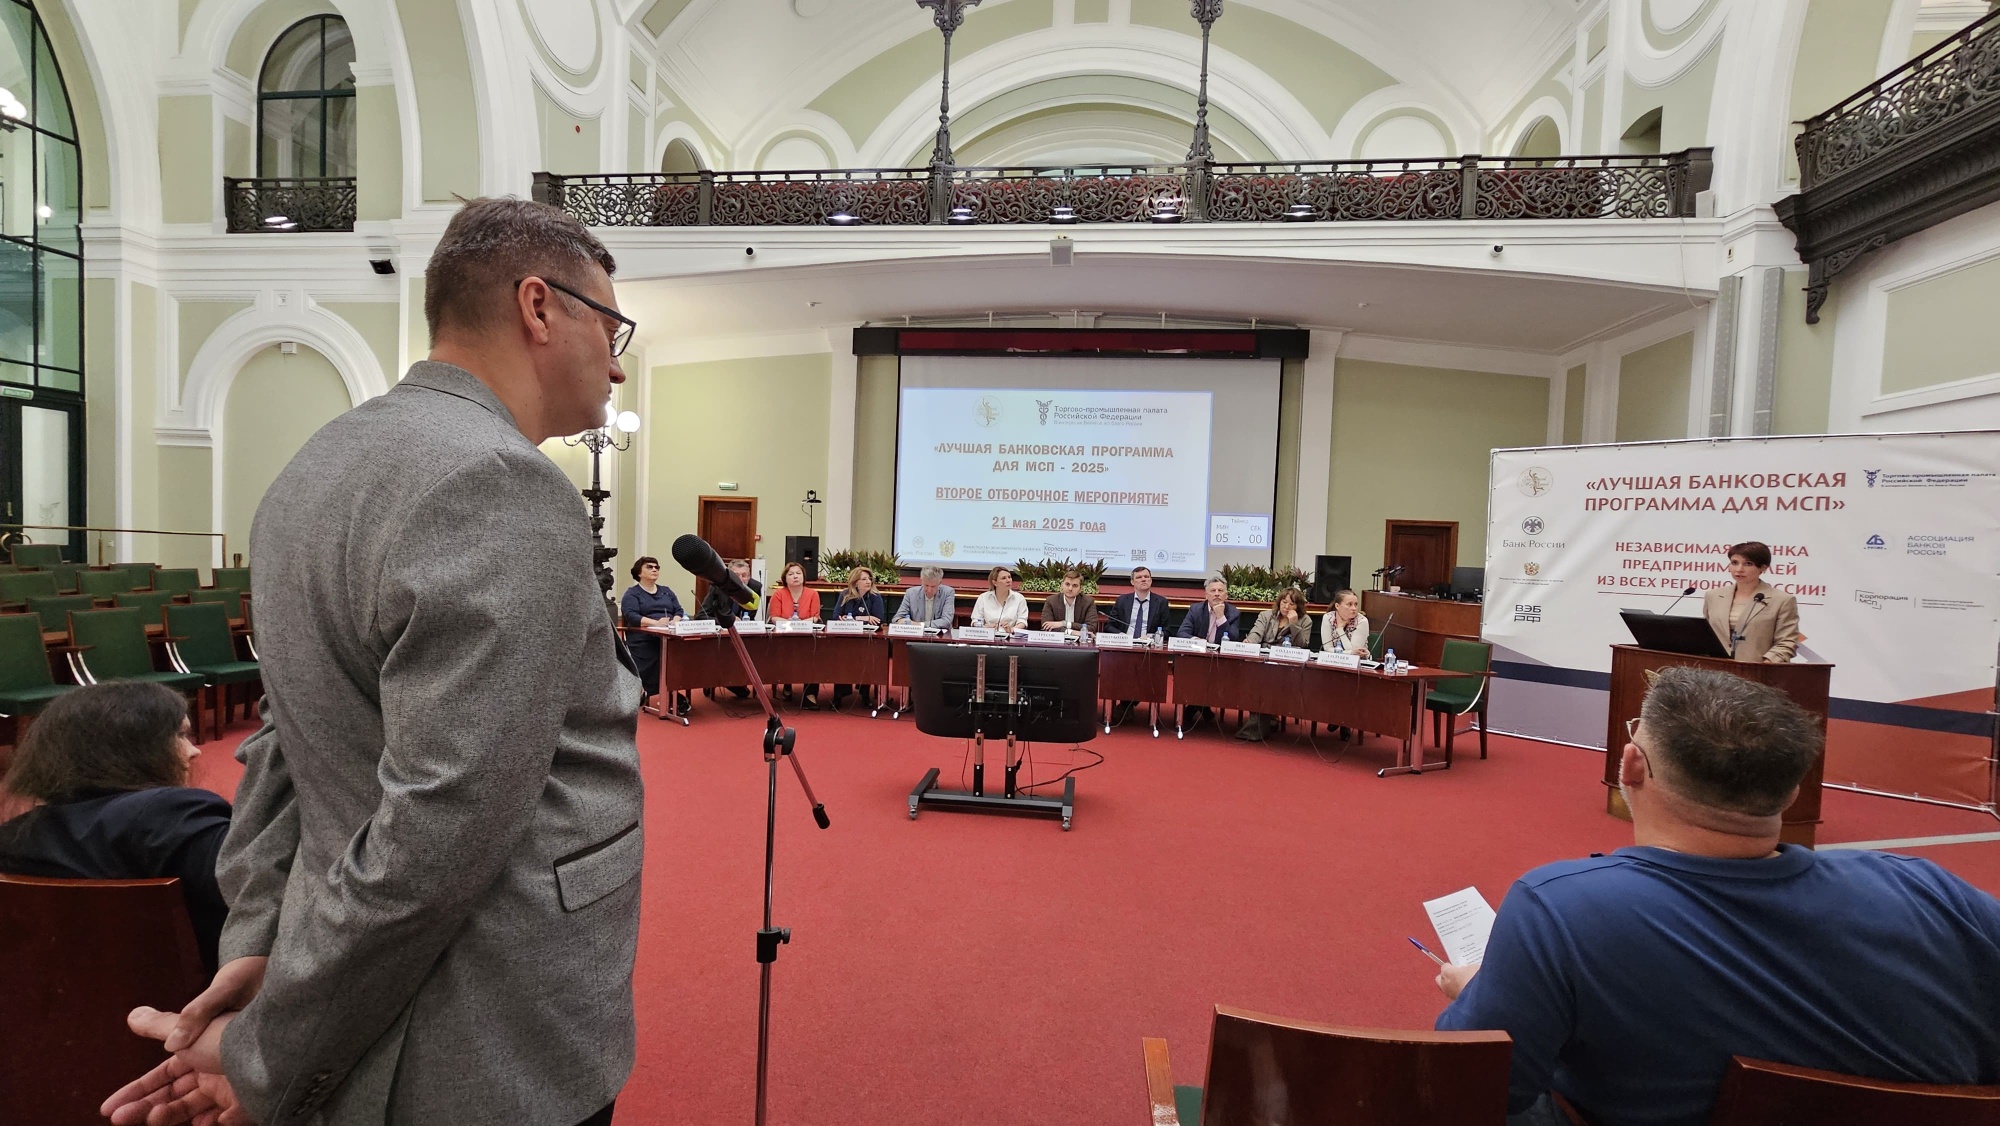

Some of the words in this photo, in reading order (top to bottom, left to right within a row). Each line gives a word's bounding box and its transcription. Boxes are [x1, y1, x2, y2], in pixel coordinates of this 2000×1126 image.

[1053, 412, 1097, 420] Российской
[1099, 413, 1142, 421] Федерации
[1054, 405, 1140, 414] Торгово-промышленная
[933, 442, 992, 454] «ЛУЧШАЯ
[998, 443, 1085, 456] БАНКОВСКАЯ
[1091, 445, 1174, 458] ПРОГРАММА
[992, 460, 1019, 473] ДЛЯ
[1025, 461, 1055, 473] МСП
[1071, 462, 1110, 474] 2025»
[1586, 475, 1682, 491] «ЛУЧШАЯ
[1688, 472, 1847, 489] БАНКОВСКАЯ
[935, 486, 983, 500] ВТОРОЕ
[987, 487, 1069, 503] ОТБОРОЧНОЕ
[1074, 490, 1169, 506] МЕРОПРИЯТИЕ
[1584, 496, 1716, 511] ПРОГРАММА
[1721, 496, 1769, 514] ДЛЯ
[1776, 495, 1846, 511] МСП»
[992, 516, 1007, 529] 21
[1012, 518, 1037, 530] мая
[1042, 517, 1075, 531] 2025
[1079, 520, 1107, 533] года
[1215, 532, 1229, 543] 05
[1248, 533, 1263, 544] 00
[1502, 539, 1527, 548] Банк
[1528, 539, 1566, 549] России
[1615, 541, 1732, 555] НЕЗАВИСИМАЯ
[1622, 559, 1797, 576] ПРЕДПРИНИМЛЕЙ
[1597, 575, 1615, 586] ИЗ
[1619, 576, 1657, 588] ВСЕХ
[1660, 577, 1733, 591] РЕГИОНО
[1858, 598, 1878, 606] МСП
[1859, 593, 1909, 601] Корпорация
[1514, 604, 1542, 613] ВЭБ
